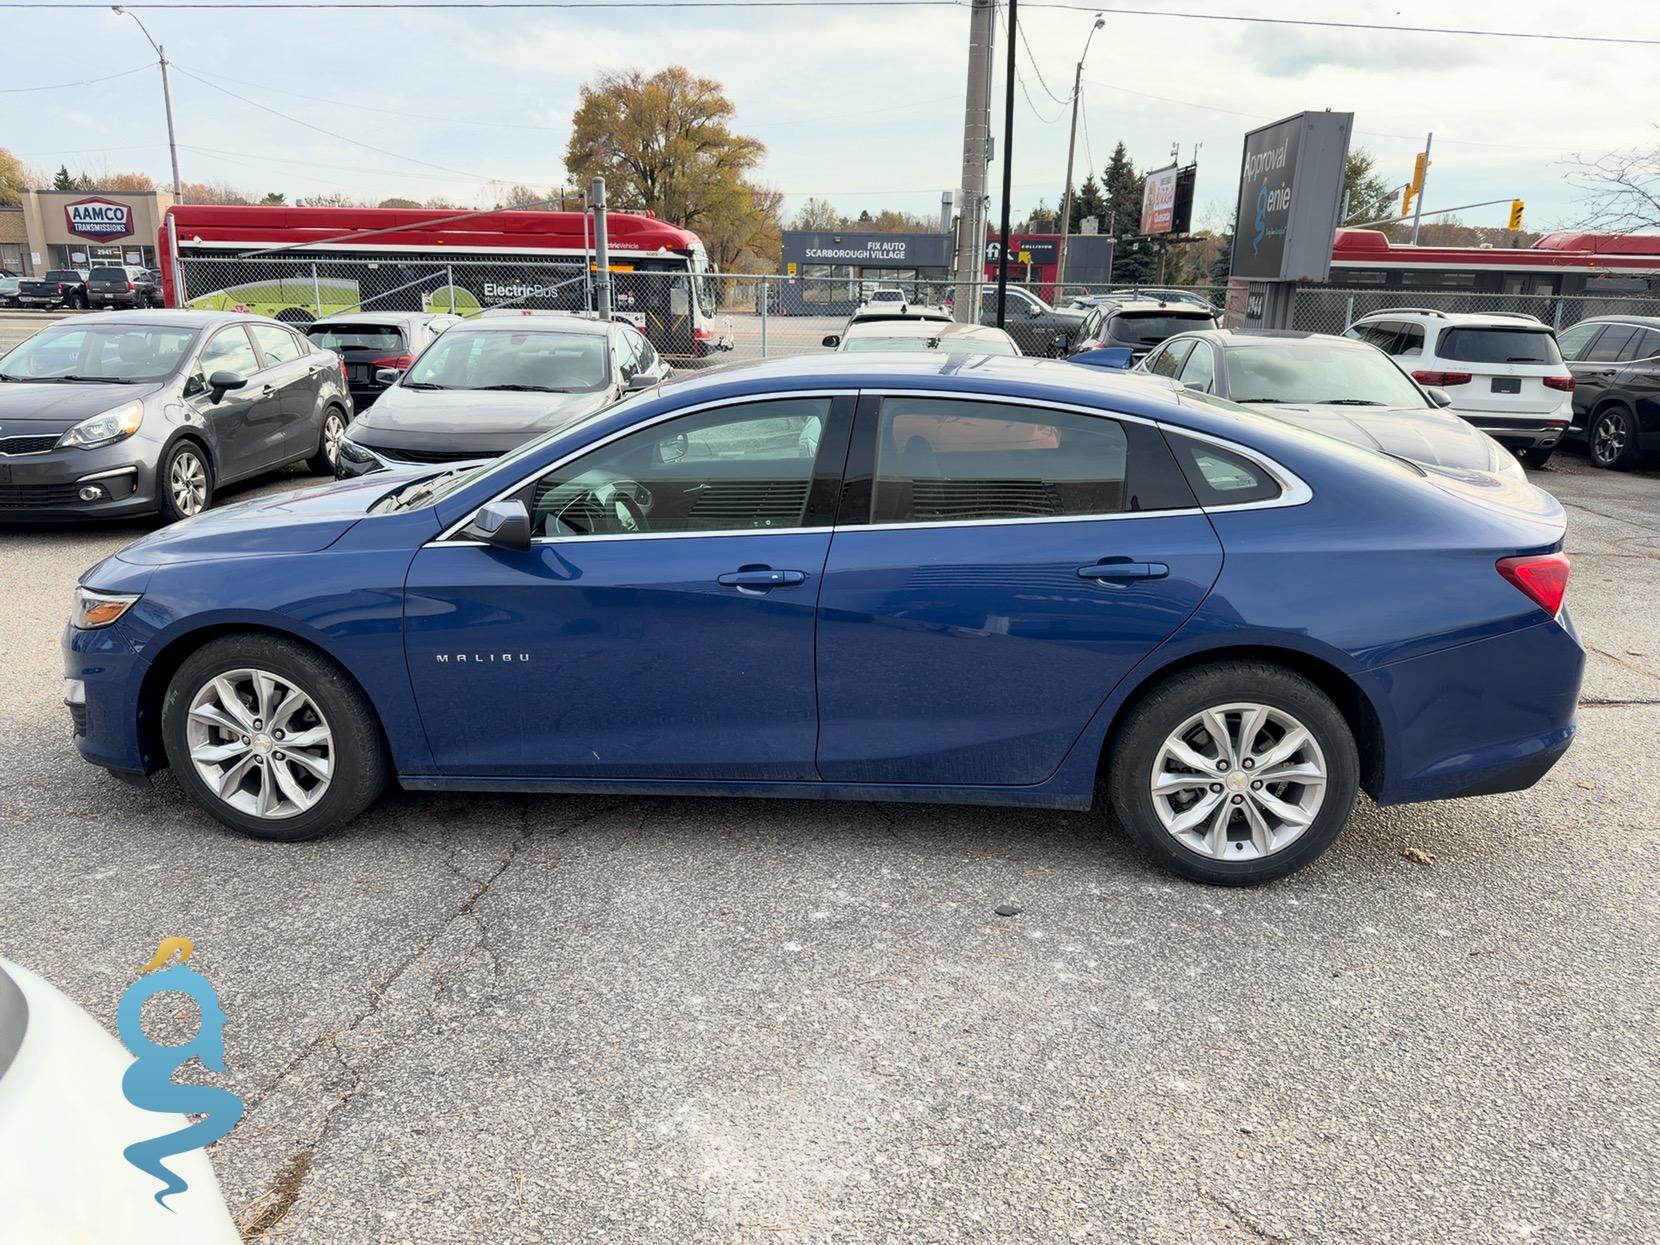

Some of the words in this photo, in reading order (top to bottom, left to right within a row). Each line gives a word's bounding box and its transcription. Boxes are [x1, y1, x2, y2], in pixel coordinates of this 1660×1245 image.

[1243, 138, 1289, 182] Approval
[73, 207, 124, 221] AAMCO
[74, 223, 126, 232] TRANSMISSIONS
[867, 242, 880, 250] FIX
[882, 242, 905, 251] AUTO
[805, 249, 869, 258] SCARBOROUGH
[870, 250, 905, 259] VILLAGE
[436, 654, 529, 662] MALIBU
